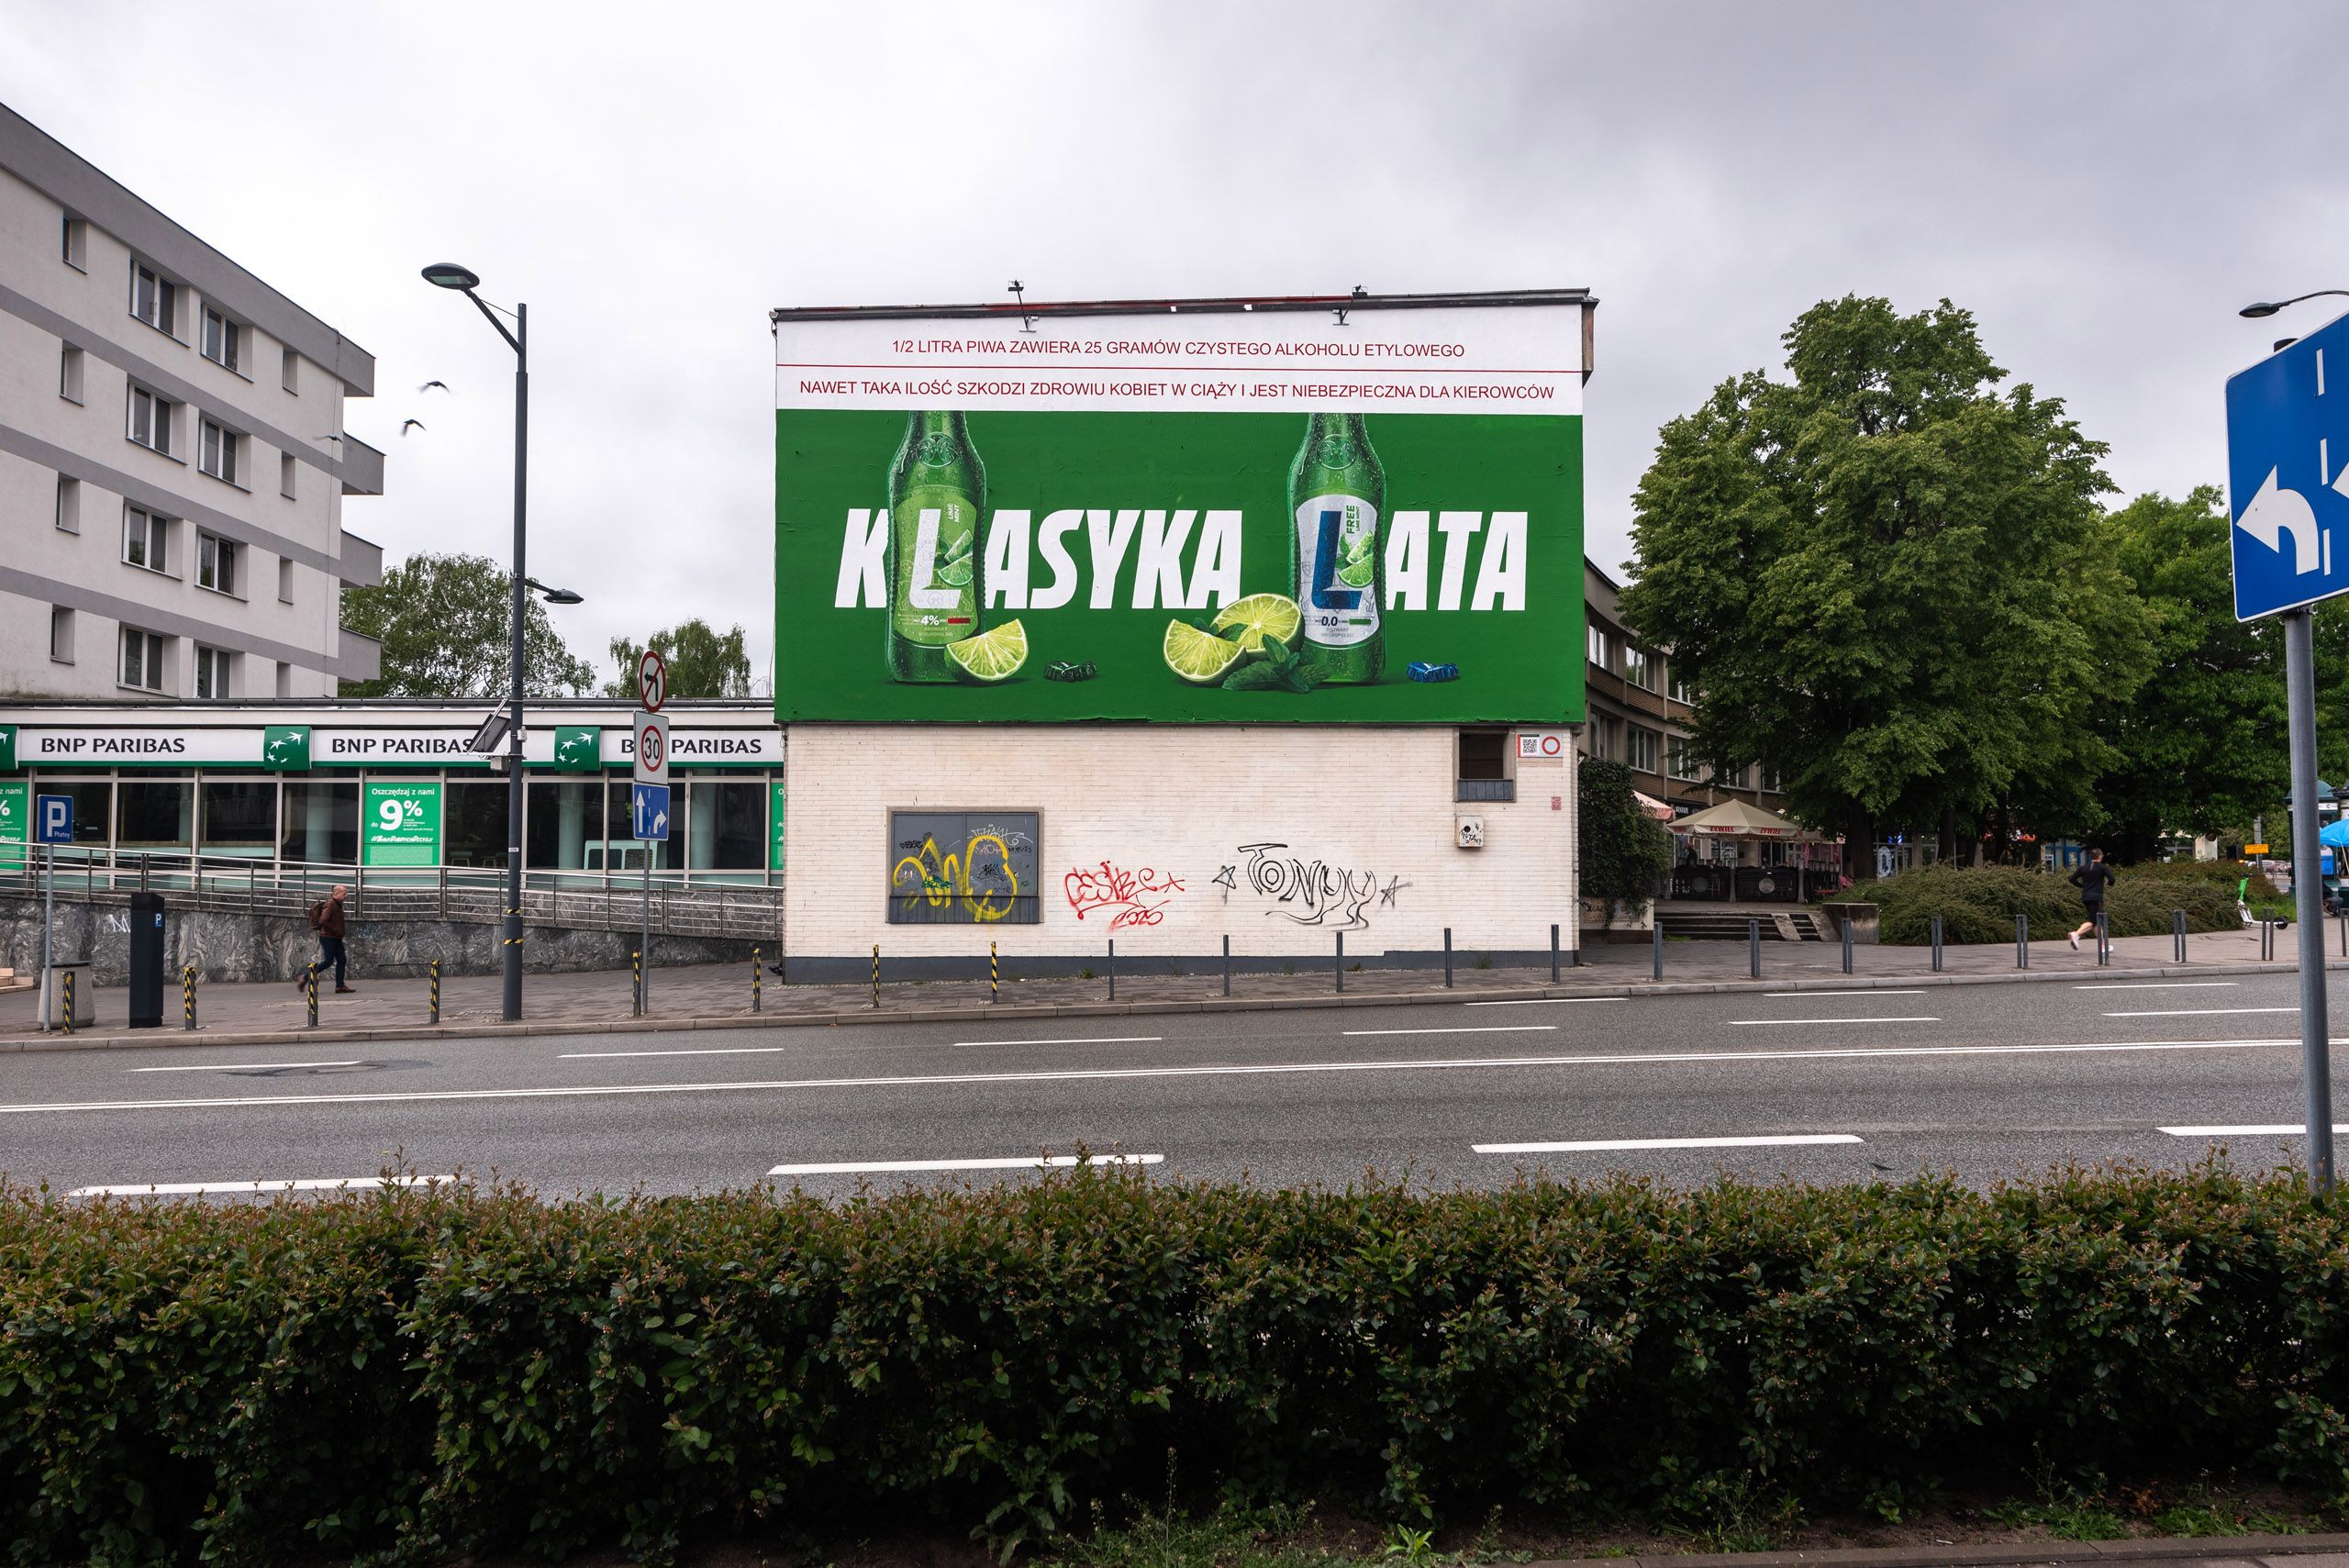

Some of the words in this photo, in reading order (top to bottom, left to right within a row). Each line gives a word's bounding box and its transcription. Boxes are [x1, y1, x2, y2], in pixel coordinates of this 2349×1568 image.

[893, 339, 914, 353] 1/2
[918, 339, 963, 353] LITRA
[966, 340, 1007, 353] PIWA
[1008, 340, 1081, 354] ZAWIERA
[1085, 340, 1102, 354] 25
[1106, 339, 1182, 355] GRAMÓW
[1185, 341, 1272, 356] CZYSTEGO
[1275, 343, 1360, 356] ALKOHOLU
[1364, 343, 1465, 357] ETYLOWEGO
[800, 381, 857, 395] NAWET
[861, 381, 901, 395] TAKA
[905, 379, 952, 395] ILOŚĆ
[957, 382, 1025, 395] SZKODZI
[1030, 382, 1106, 395] ZDROWIU
[1109, 383, 1168, 396] KOBIET
[1170, 384, 1186, 396] W
[1190, 382, 1237, 399] CIĄŻY
[1241, 384, 1245, 396] I
[1249, 384, 1289, 397] JEST
[1292, 384, 1417, 398] NIEBEZPIECZNA
[1419, 385, 1451, 398] DLA
[1453, 384, 1555, 400] KIEROWCÓW
[1345, 505, 1355, 534] FREE
[834, 508, 1243, 609] KLASYKA
[1311, 510, 1529, 611] LATA
[920, 615, 940, 626] 4%
[41, 738, 86, 753] BNP
[93, 738, 185, 753] PARIBAS
[331, 739, 377, 753] BNP
[383, 739, 473, 753] PARIBAS
[644, 737, 661, 760] 30
[672, 739, 763, 754] PARIBAS
[372, 788, 410, 797] Oszczędzaj
